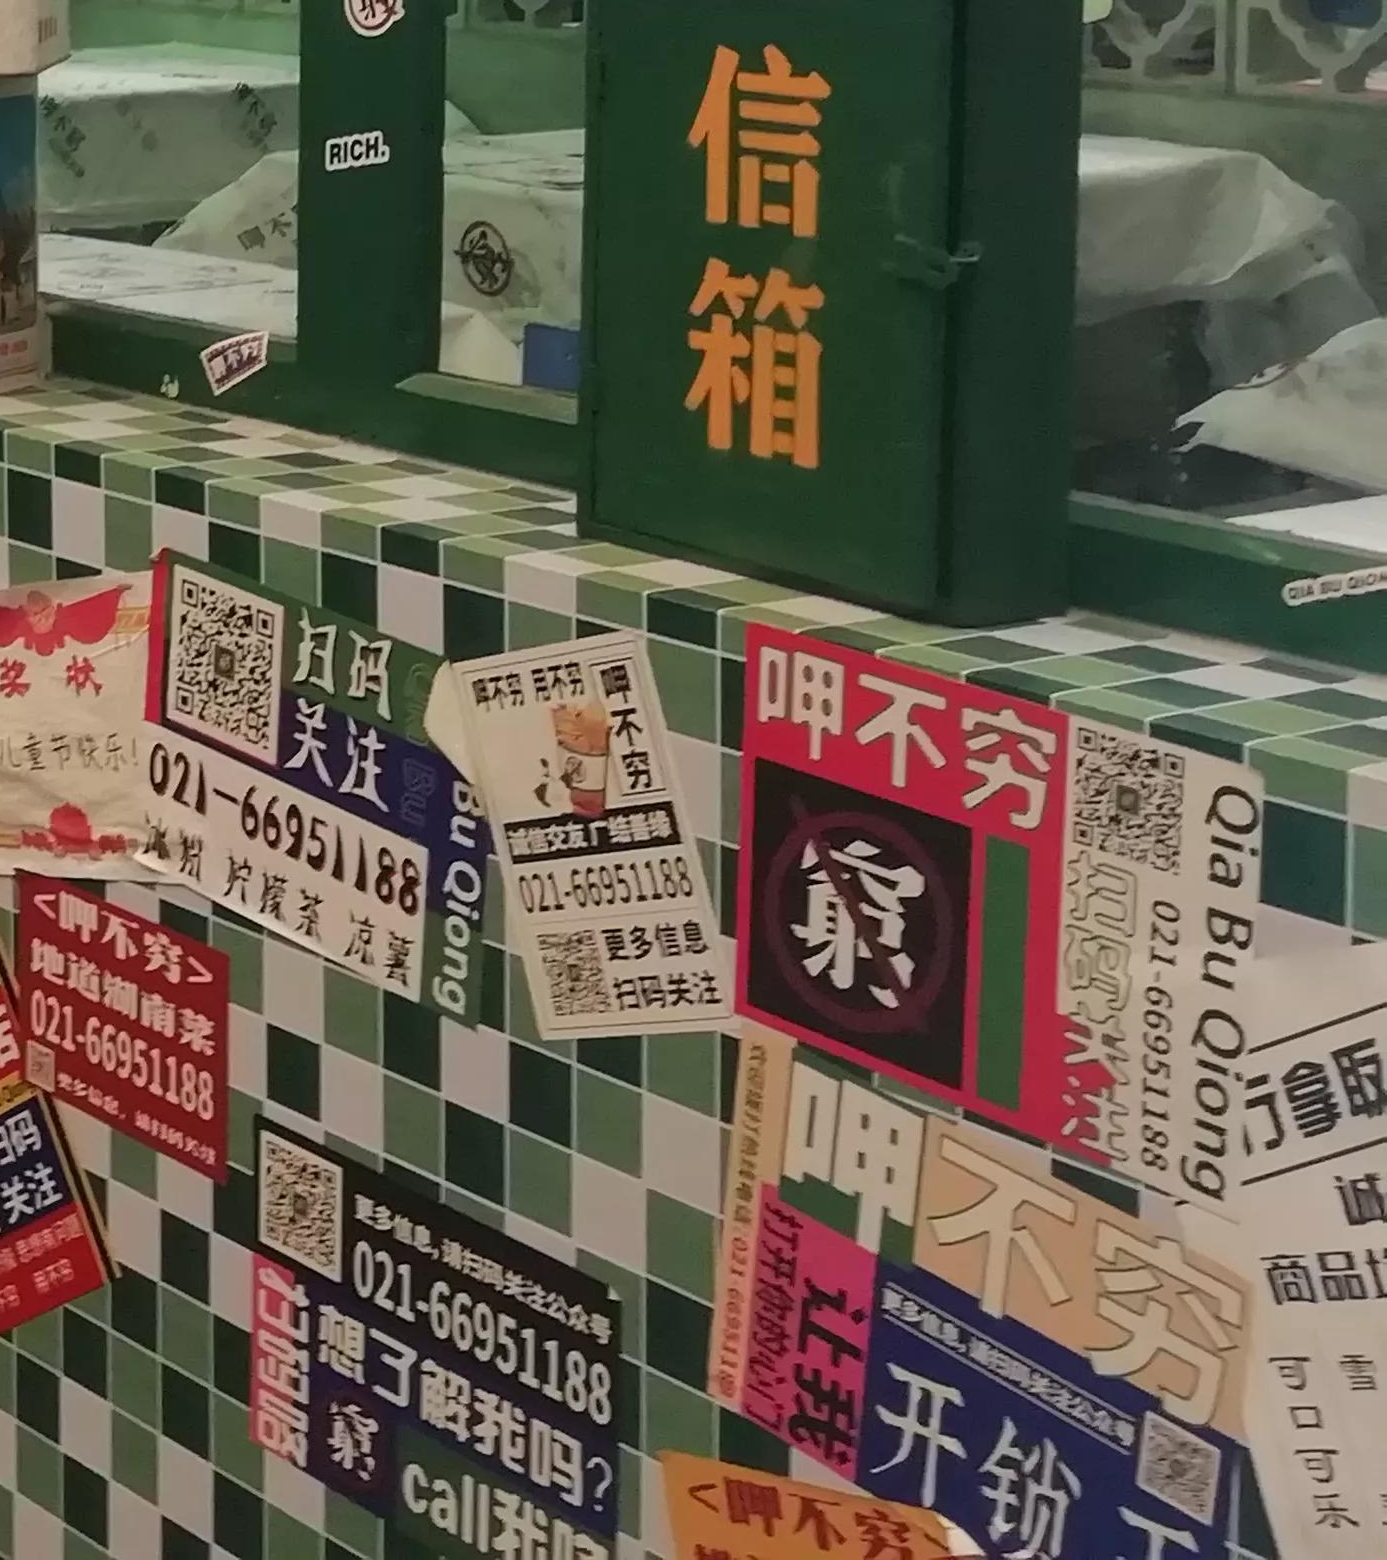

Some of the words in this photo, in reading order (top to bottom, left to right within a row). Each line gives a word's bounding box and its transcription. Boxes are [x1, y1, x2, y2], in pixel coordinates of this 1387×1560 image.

[329, 137, 386, 166] RICH.
[683, 42, 832, 470] 信箱
[292, 605, 394, 722] 扫码
[470, 669, 527, 713] 呷不穷
[529, 660, 586, 703] 用不穷
[599, 663, 653, 792] 呷不穷
[284, 696, 390, 814] 关注
[757, 645, 1058, 831] 呷不穷
[149, 741, 421, 918] 021-66951188
[518, 854, 695, 914] 021-66951188
[1202, 784, 1261, 891] Qia
[30, 937, 217, 1056] 地道湖南菜
[432, 860, 482, 1017] Qiong
[600, 918, 710, 963] 更多信息
[612, 969, 724, 1012] 扫码关注
[1198, 904, 1255, 991] Bu
[30, 989, 215, 1121] 021-66951188
[1138, 899, 1182, 1173] 021-66951188
[1178, 1009, 1248, 1201] Qiong
[0, 1160, 64, 1226] 关注
[780, 1058, 1247, 1430] 呷不穷
[353, 1240, 613, 1426] 021-66951188
[787, 1281, 868, 1468] 让我
[1267, 1354, 1359, 1530] 可口可乐
